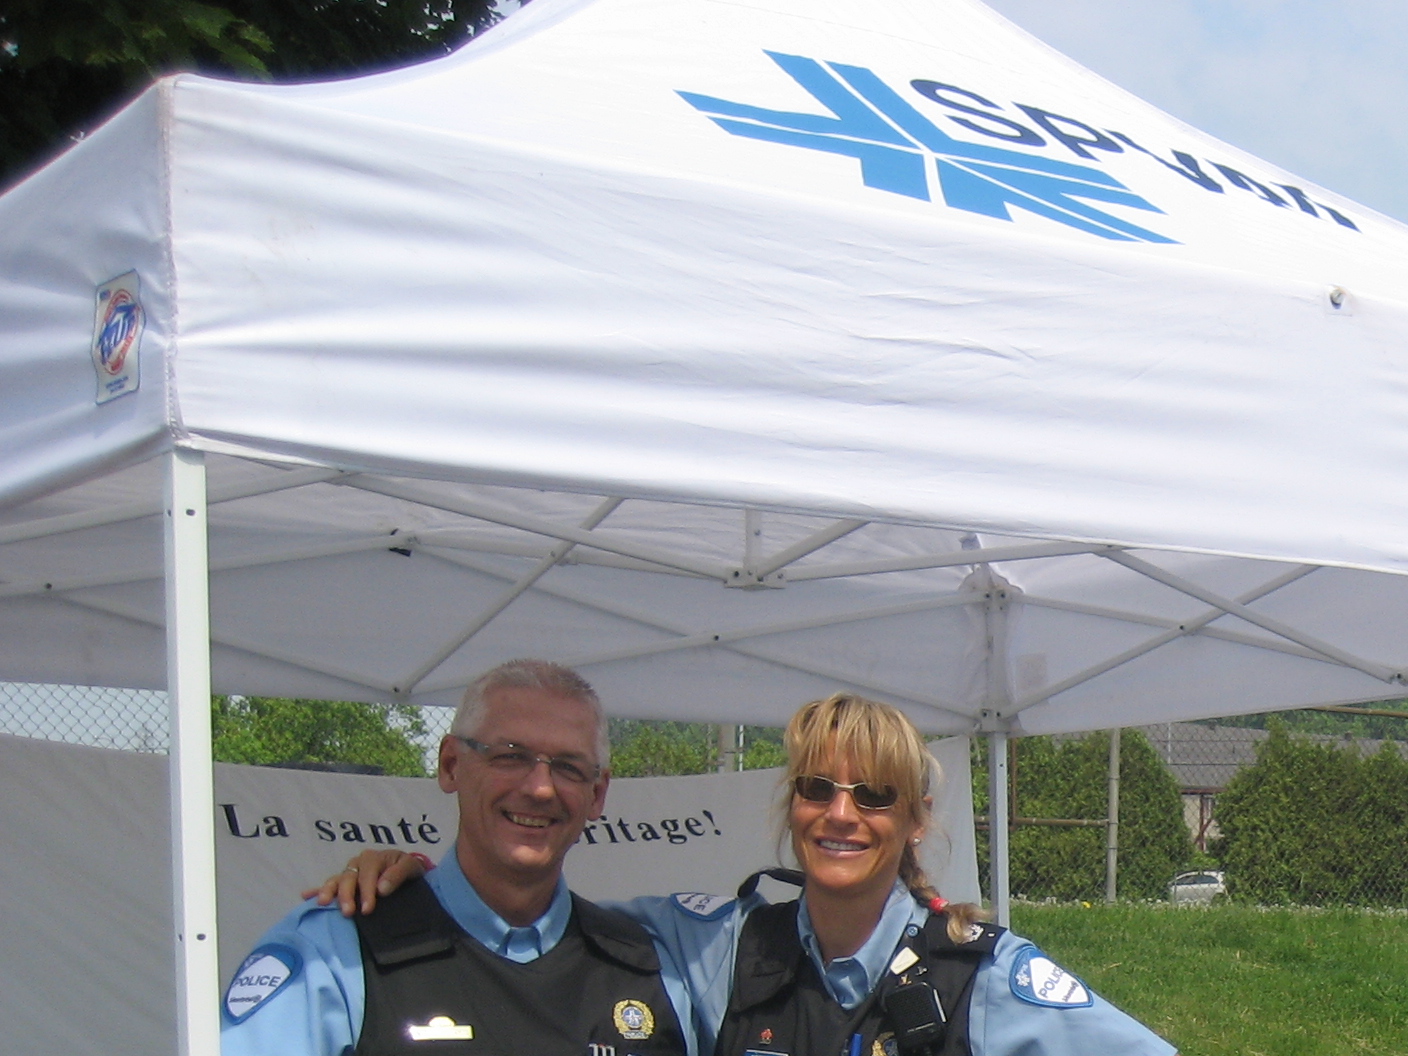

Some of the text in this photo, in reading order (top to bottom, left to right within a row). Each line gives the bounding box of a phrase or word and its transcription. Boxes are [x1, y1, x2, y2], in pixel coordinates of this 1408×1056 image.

[218, 803, 722, 845] La santé ritage!
